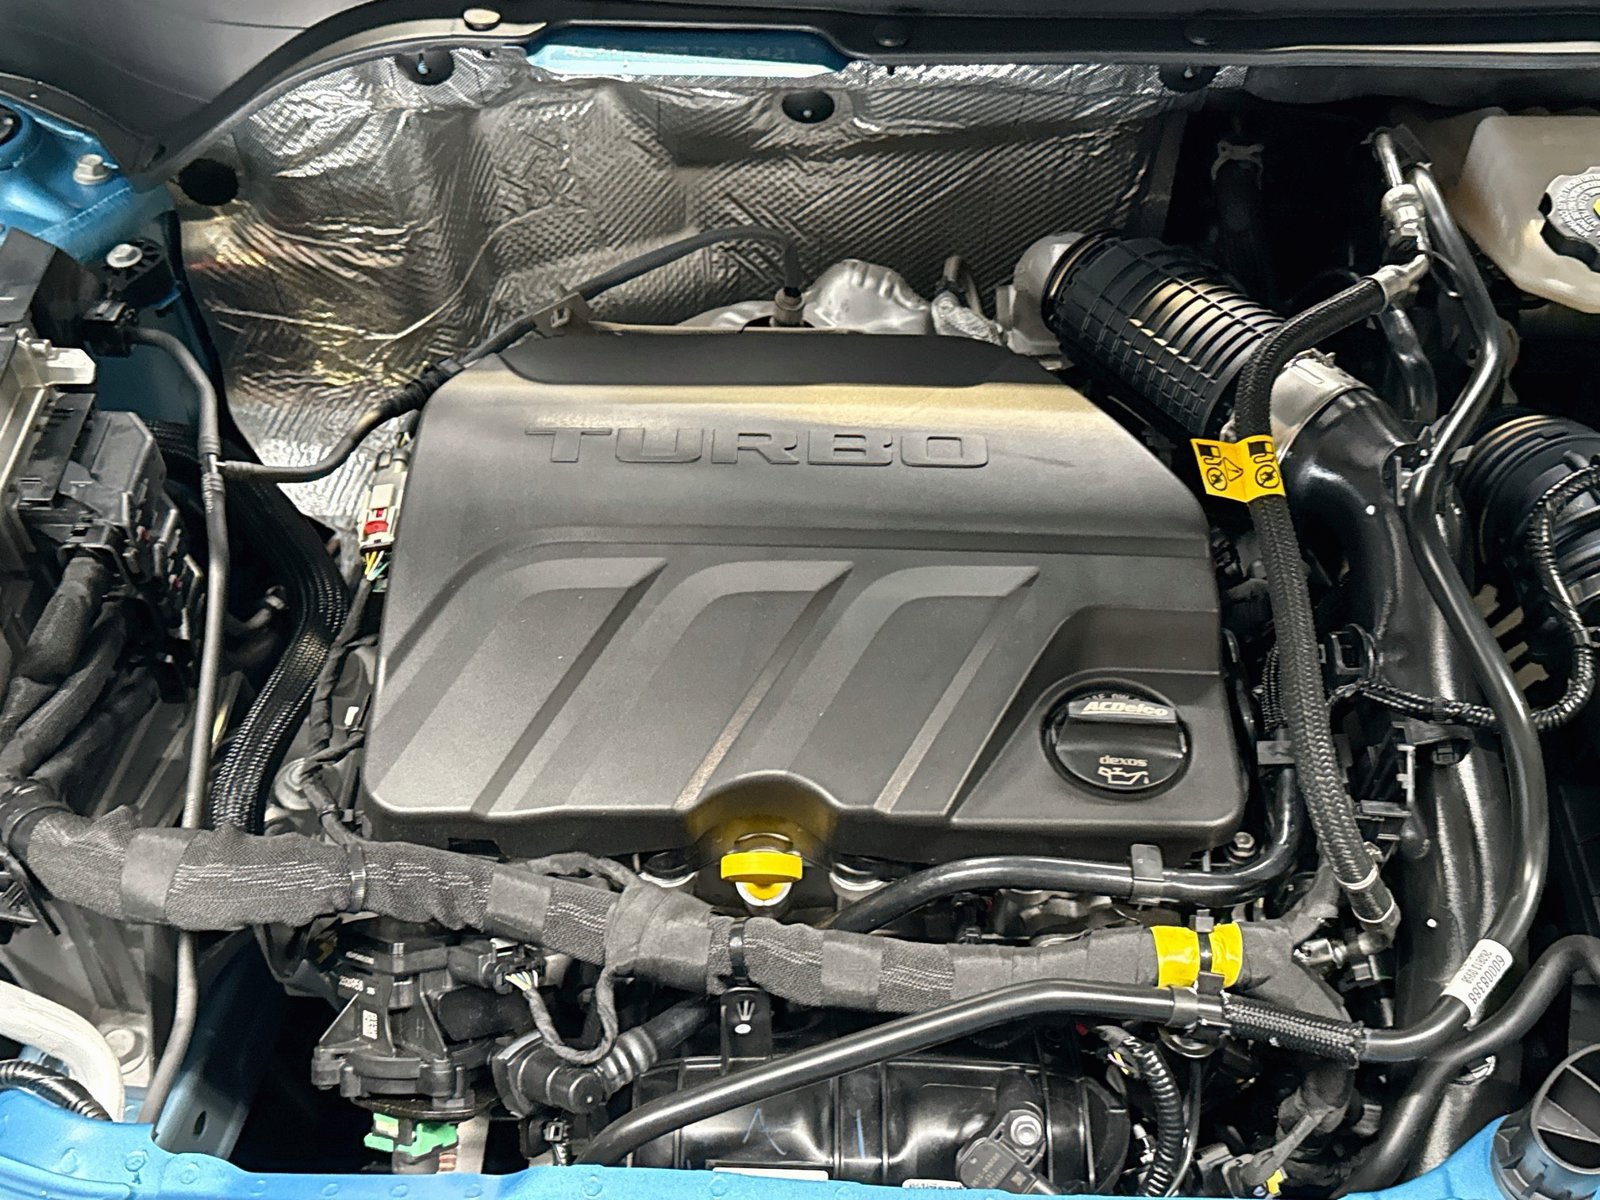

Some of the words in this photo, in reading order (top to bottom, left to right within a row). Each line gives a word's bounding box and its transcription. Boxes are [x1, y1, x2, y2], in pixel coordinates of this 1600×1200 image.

[525, 427, 990, 467] TURBO
[1081, 701, 1169, 717] ACDelco
[1098, 755, 1149, 768] dexos
[1467, 954, 1506, 1005] 60008388
